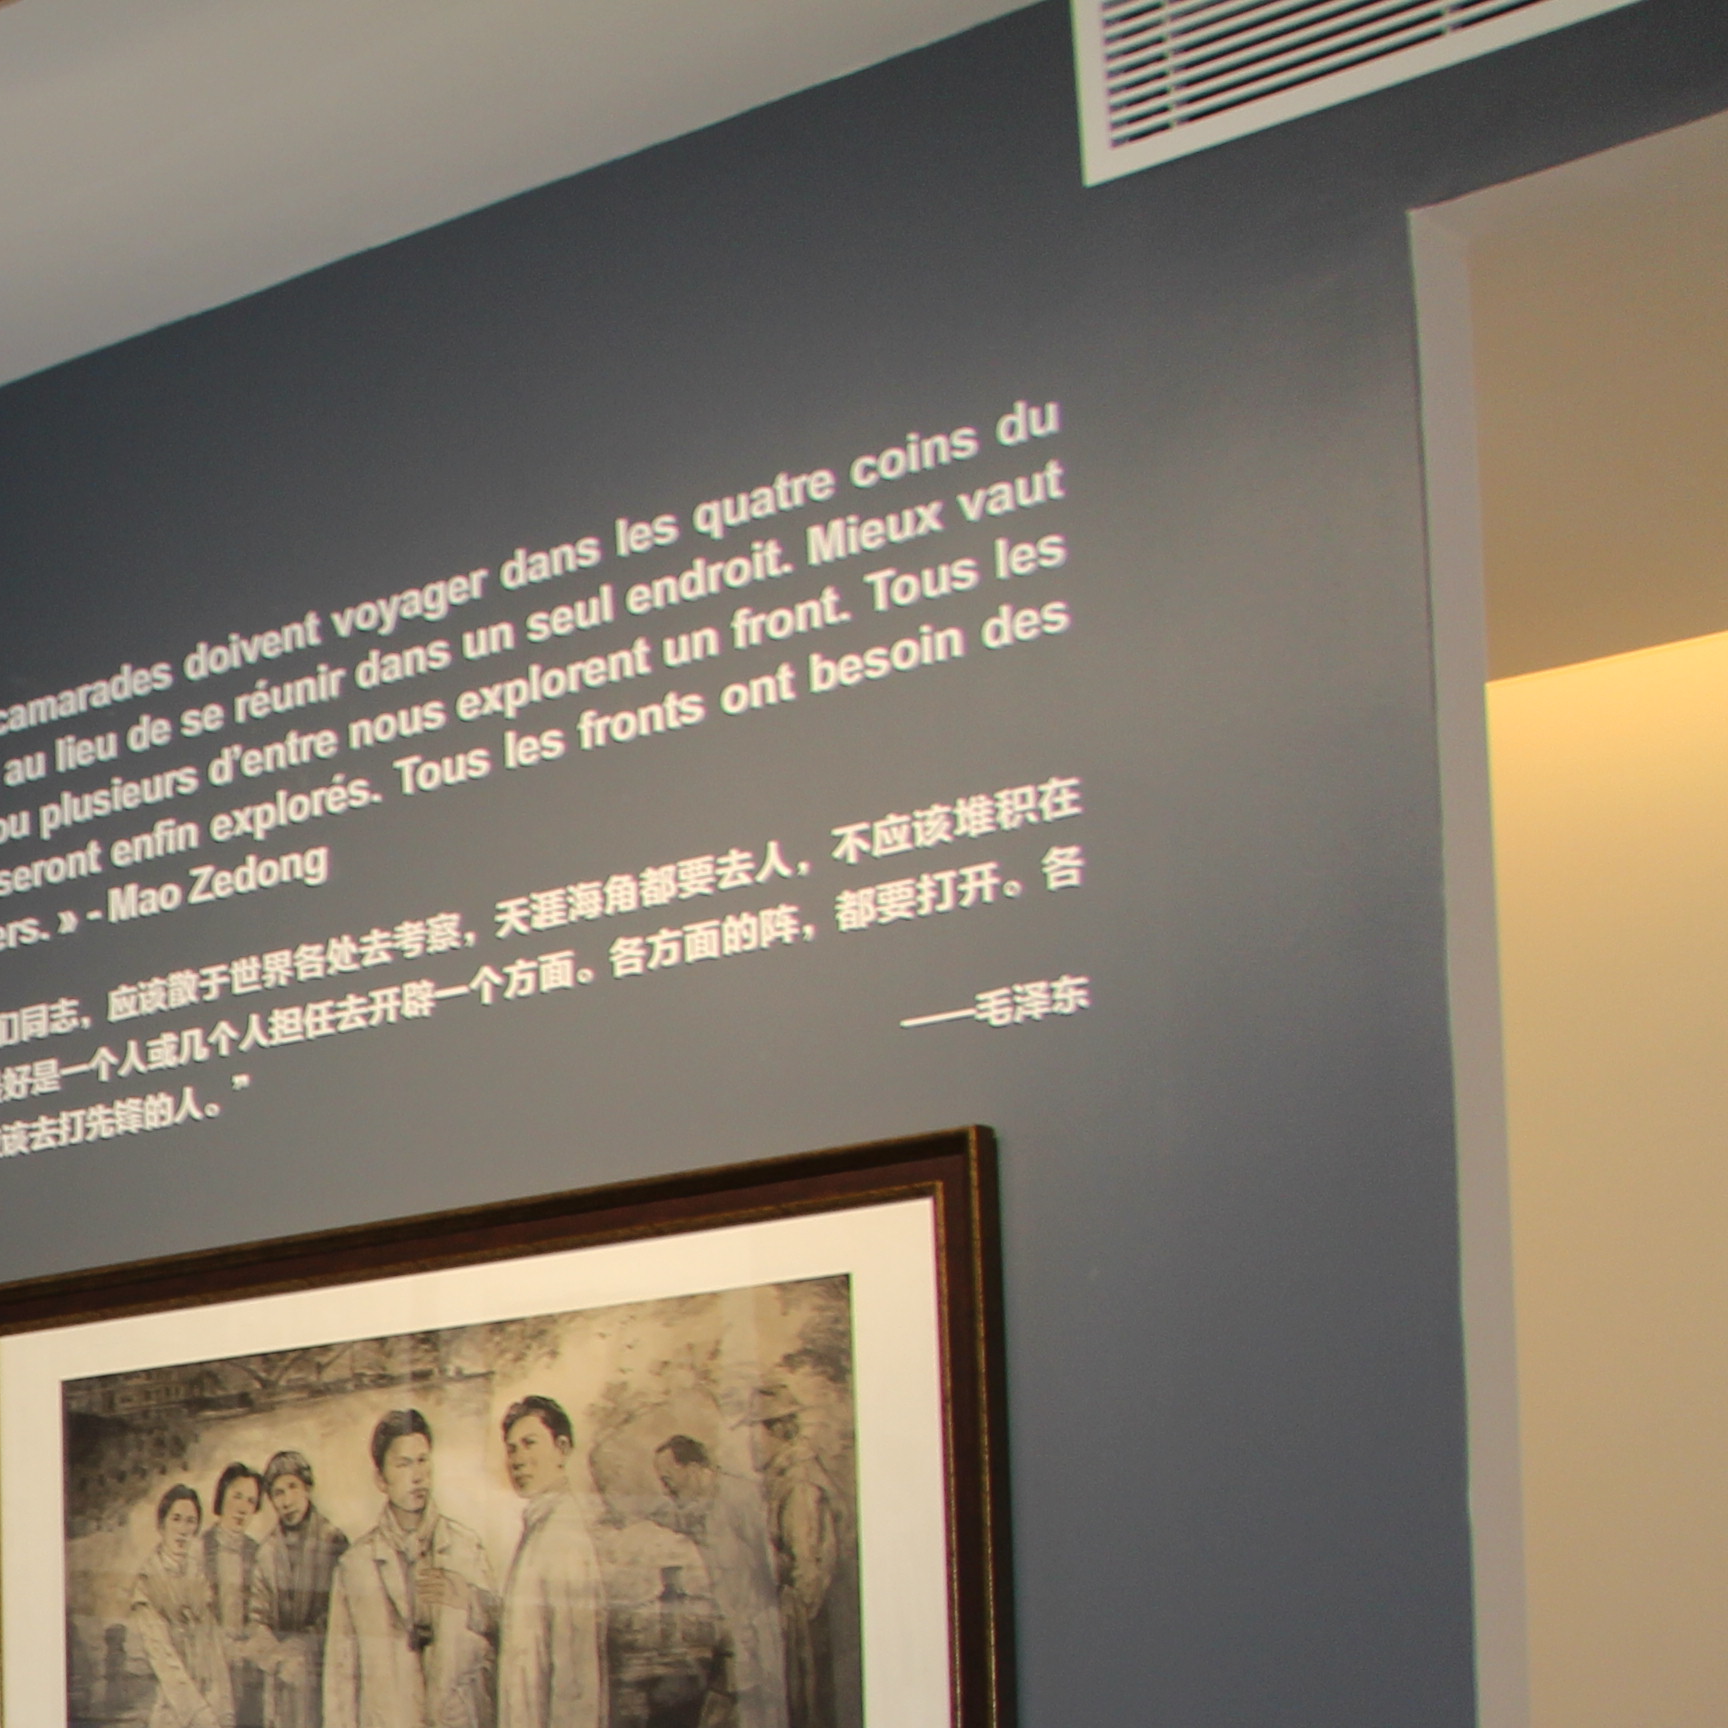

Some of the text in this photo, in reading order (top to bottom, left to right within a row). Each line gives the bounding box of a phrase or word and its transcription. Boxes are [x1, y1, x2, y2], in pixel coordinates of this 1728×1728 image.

[3, 751, 47, 787] au
[55, 731, 118, 773] lieu
[126, 714, 173, 752] de
[180, 703, 225, 737] se
[234, 663, 347, 724] réunir
[355, 639, 452, 689] dans
[462, 621, 515, 660] un
[526, 584, 614, 642] seul
[625, 539, 793, 614] endroit.
[806, 501, 943, 566] Mieux
[956, 460, 1064, 521] vaut
[183, 611, 322, 681] doivent
[330, 568, 489, 638] voyager
[499, 537, 602, 590] dans
[615, 514, 680, 557] les
[693, 469, 836, 540] quatre
[850, 427, 979, 488] coins
[996, 400, 1059, 446] du
[39, 766, 200, 841] plusieurs
[207, 729, 339, 786] d’entre
[348, 700, 447, 750] nous
[456, 637, 652, 721] explorent
[662, 627, 720, 667] un
[730, 586, 851, 649] front.
[863, 558, 979, 611] Tous
[995, 535, 1066, 579] les
[110, 818, 200, 867] enfin
[209, 773, 383, 842] explorés.
[392, 748, 492, 795] Tous
[504, 729, 566, 769] les
[576, 691, 706, 750] fronts
[720, 663, 796, 714] ont
[809, 624, 964, 693] besoin
[981, 601, 1070, 649] des
[107, 882, 183, 923] Mao
[187, 846, 329, 904] Zedong
